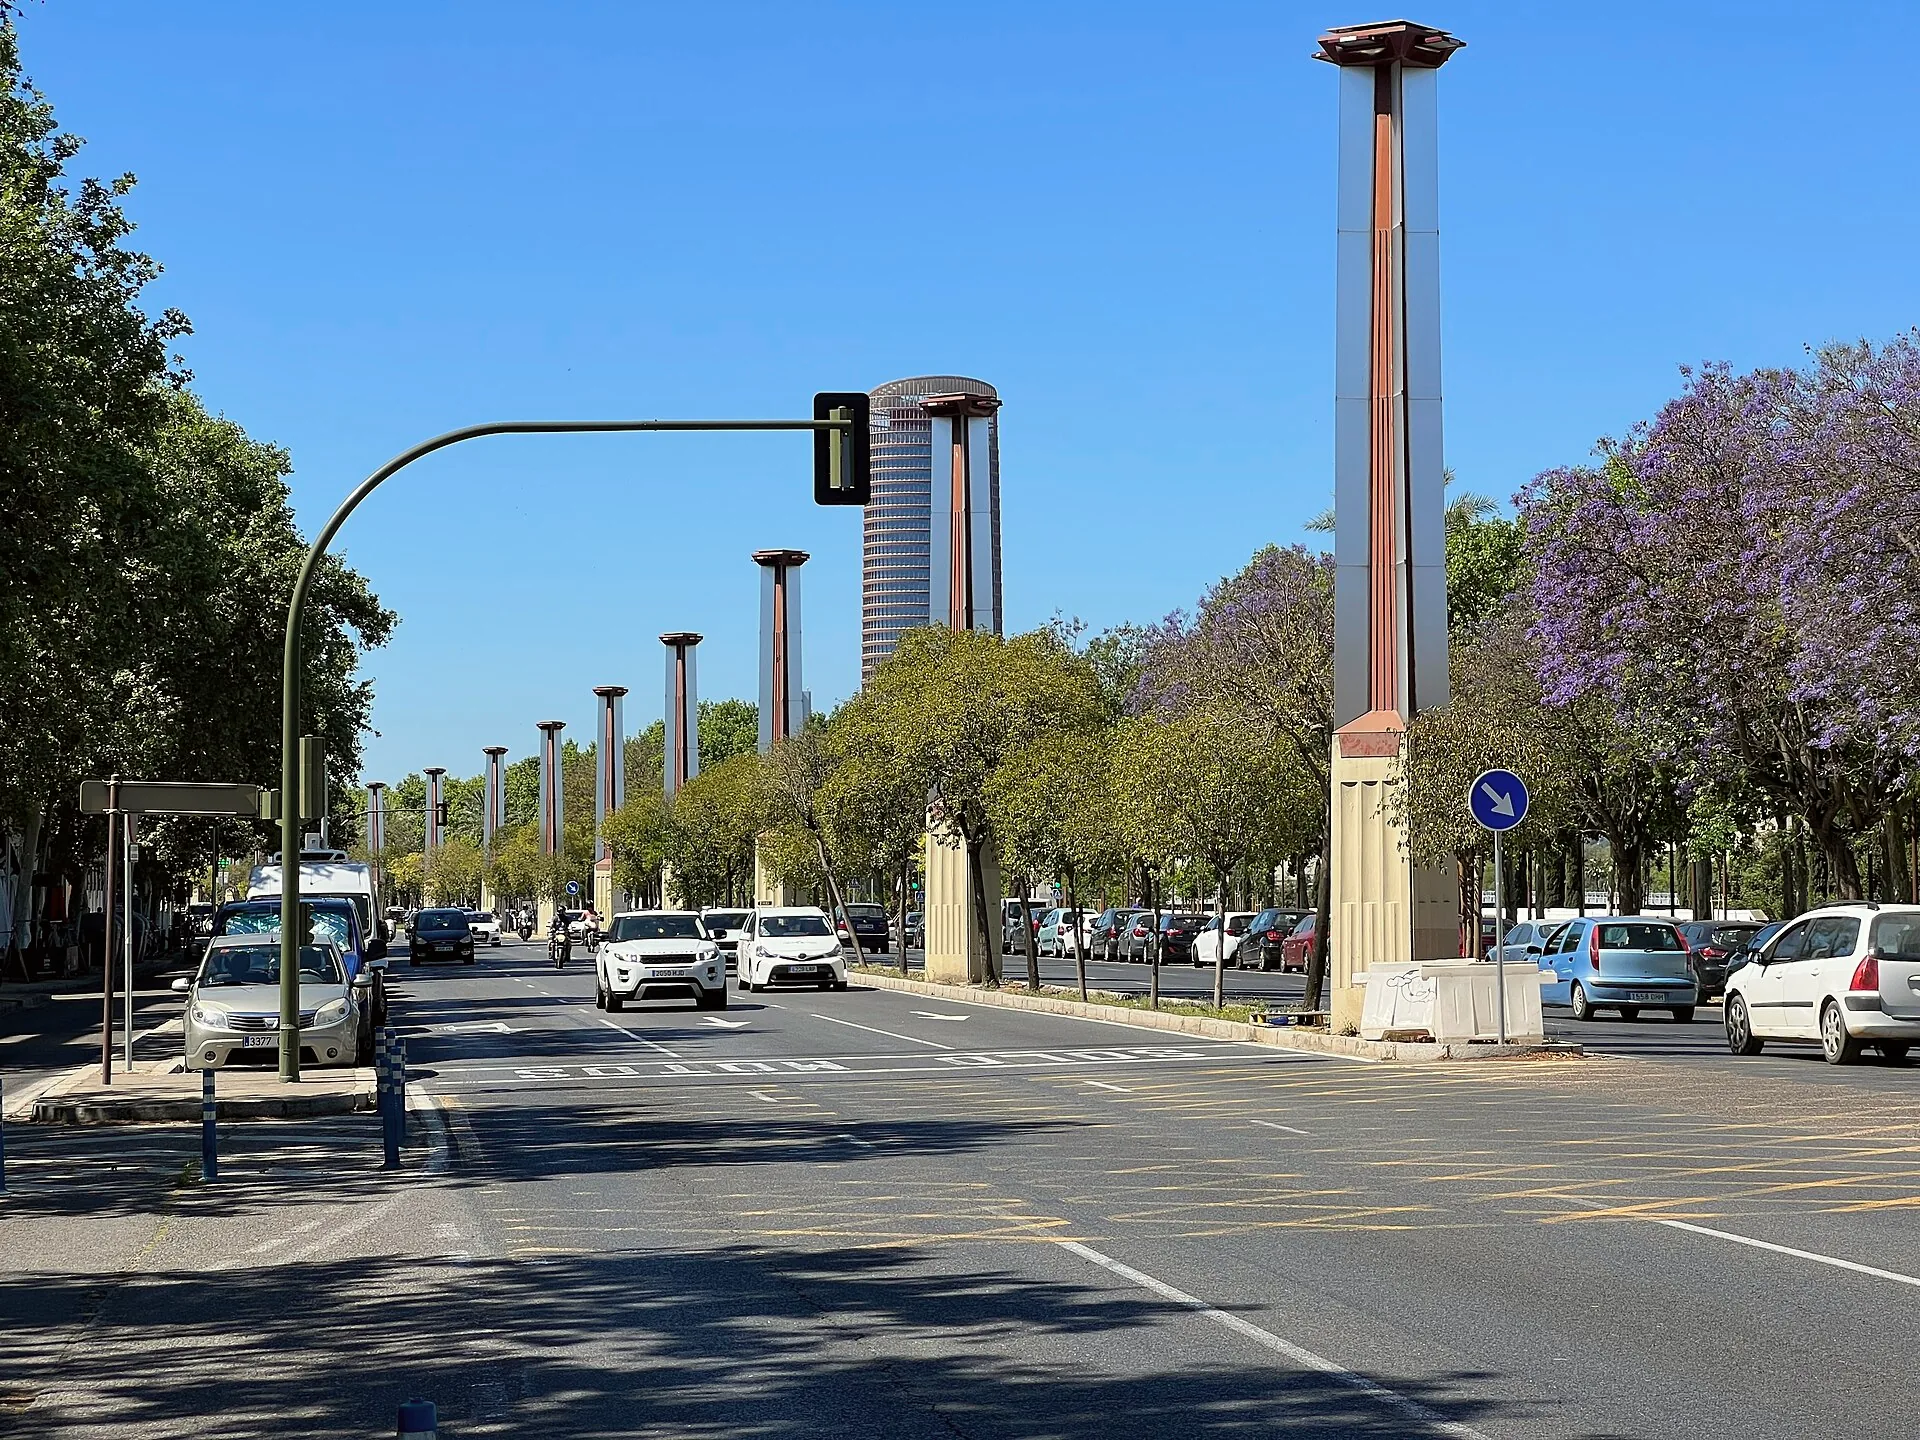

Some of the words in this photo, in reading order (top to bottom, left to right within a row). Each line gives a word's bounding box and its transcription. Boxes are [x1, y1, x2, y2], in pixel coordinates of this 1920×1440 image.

[249, 1036, 272, 1047] 3377
[934, 1049, 1206, 1066] SOLO
[513, 1061, 850, 1079] MOTOS
